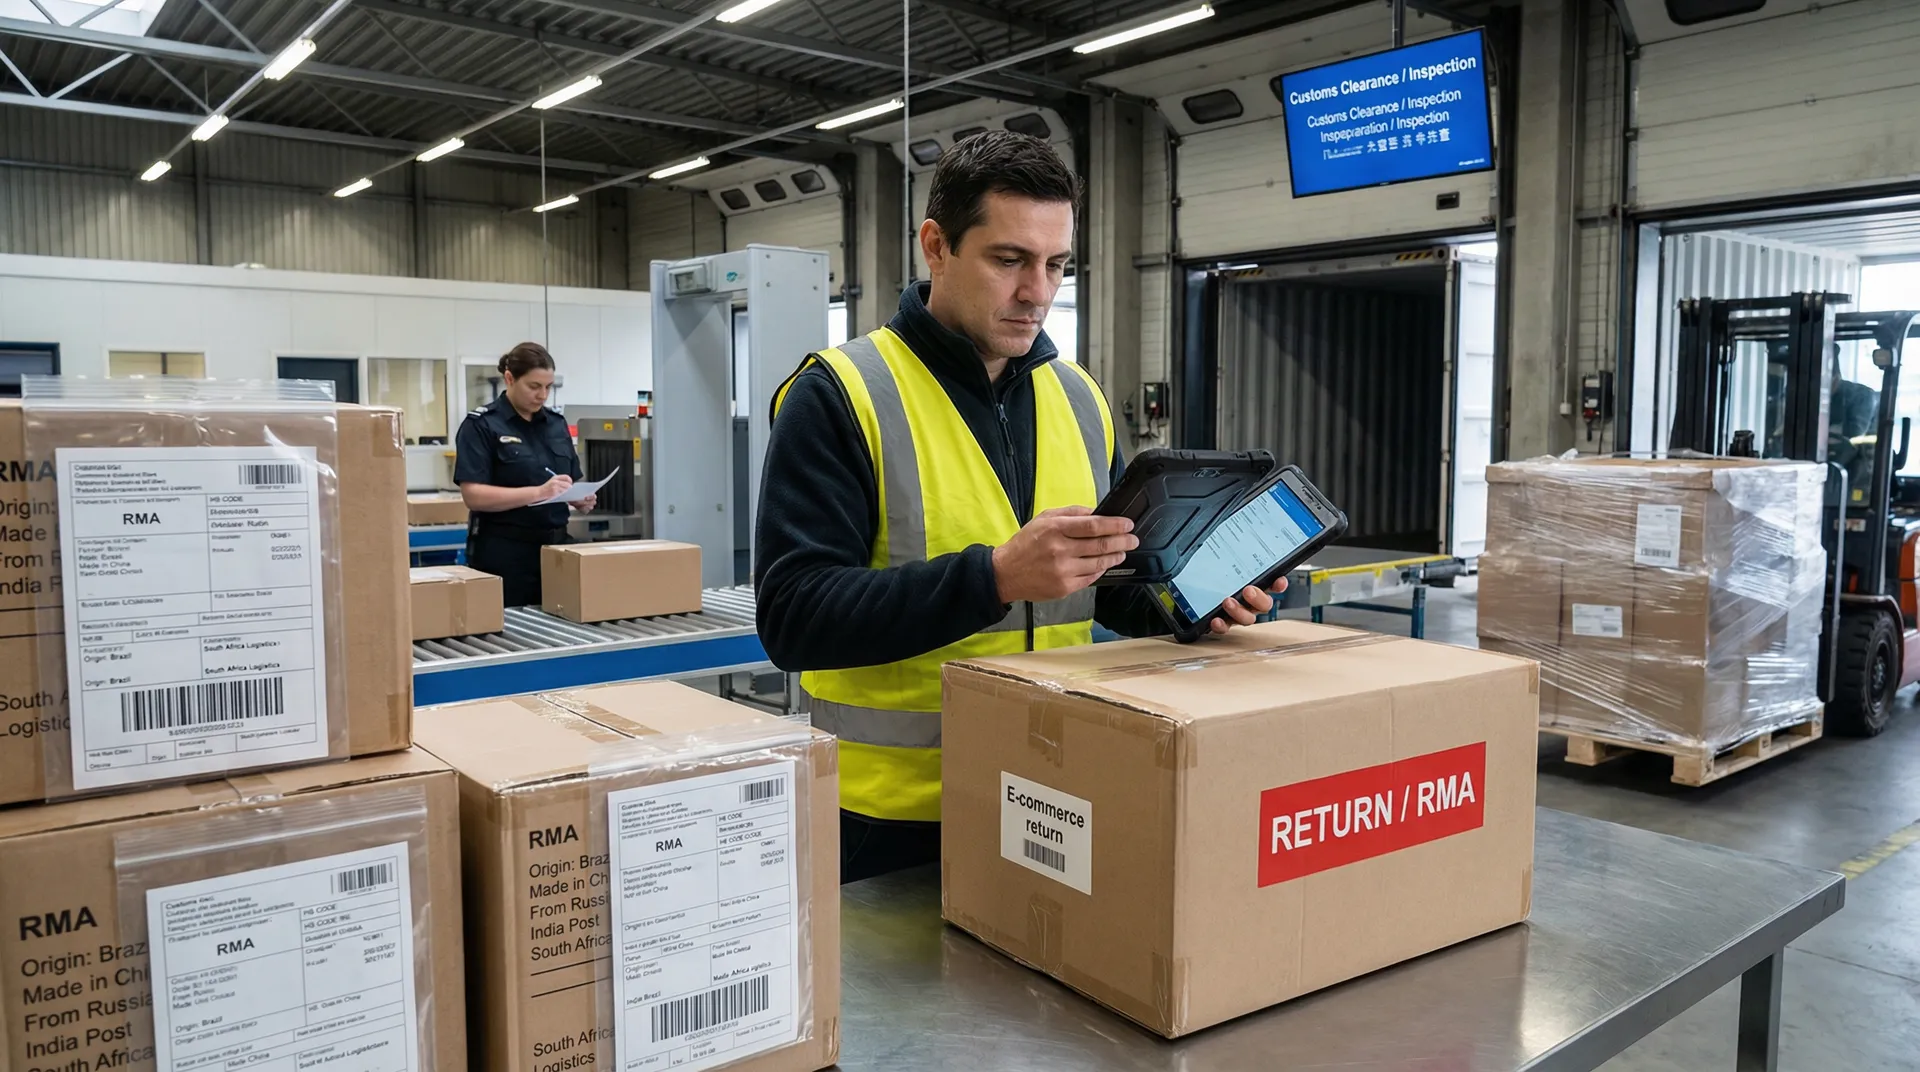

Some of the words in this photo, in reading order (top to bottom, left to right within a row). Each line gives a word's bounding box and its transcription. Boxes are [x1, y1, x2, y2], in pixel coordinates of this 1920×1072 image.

[1289, 84, 1338, 105] Customs
[1340, 72, 1399, 95] Clearance
[1401, 68, 1406, 82] /
[1409, 56, 1476, 81] Inspection
[1307, 110, 1348, 128] Customs
[1349, 100, 1399, 120] Clearance
[1407, 89, 1462, 110] Inspection
[1396, 110, 1450, 131] Inspection
[0, 498, 56, 519] rigin:
[123, 512, 161, 525] RMA
[0, 552, 43, 568] rom
[1007, 785, 1085, 828] E-commerce
[1271, 790, 1393, 854] RETURN
[1400, 785, 1410, 822] /
[1417, 771, 1476, 817] RMA
[529, 825, 578, 849] RMA
[1026, 819, 1063, 844] return
[656, 838, 683, 852] RMA
[529, 860, 575, 878] Origin:
[530, 881, 568, 899] Made
[573, 877, 584, 890] in
[19, 905, 97, 941] RMA
[530, 903, 566, 919] From
[531, 922, 564, 940] India
[569, 914, 600, 932] Post
[217, 938, 255, 956] RMA
[530, 941, 571, 961] South
[575, 933, 612, 951] Africa
[21, 951, 92, 977] Origin:
[23, 980, 83, 1006] Made
[90, 974, 108, 992] in
[24, 1008, 80, 1032] From
[88, 990, 153, 1018] Russia
[26, 1036, 78, 1059] India
[86, 1021, 132, 1046] Post
[533, 1035, 574, 1057] South
[578, 1027, 615, 1046] Africa
[95, 1047, 154, 1071] Africa
